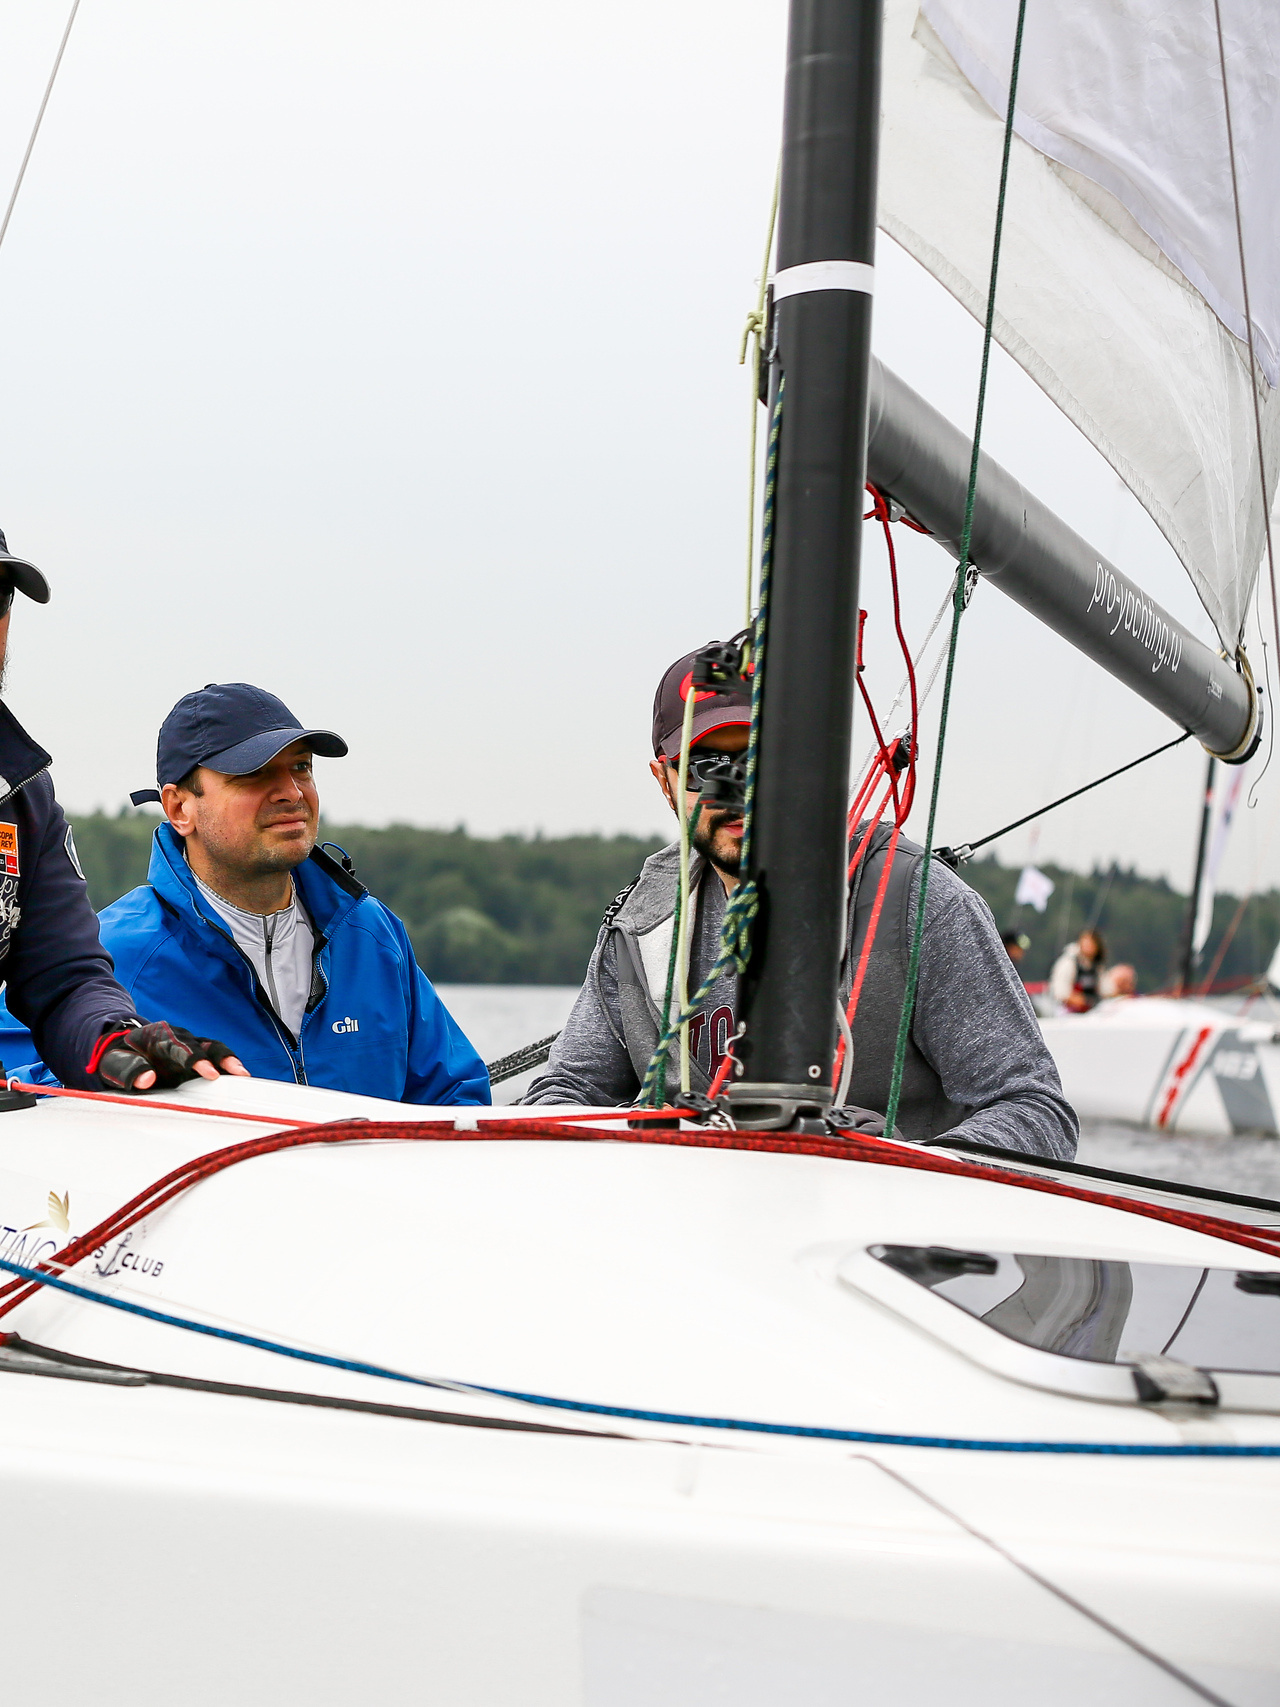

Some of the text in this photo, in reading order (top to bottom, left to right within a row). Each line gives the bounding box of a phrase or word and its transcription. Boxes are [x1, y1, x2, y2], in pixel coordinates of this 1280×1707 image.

[1086, 561, 1183, 673] pro-yachting.ru
[331, 1016, 359, 1034] Gill
[121, 1252, 164, 1277] CLUB
